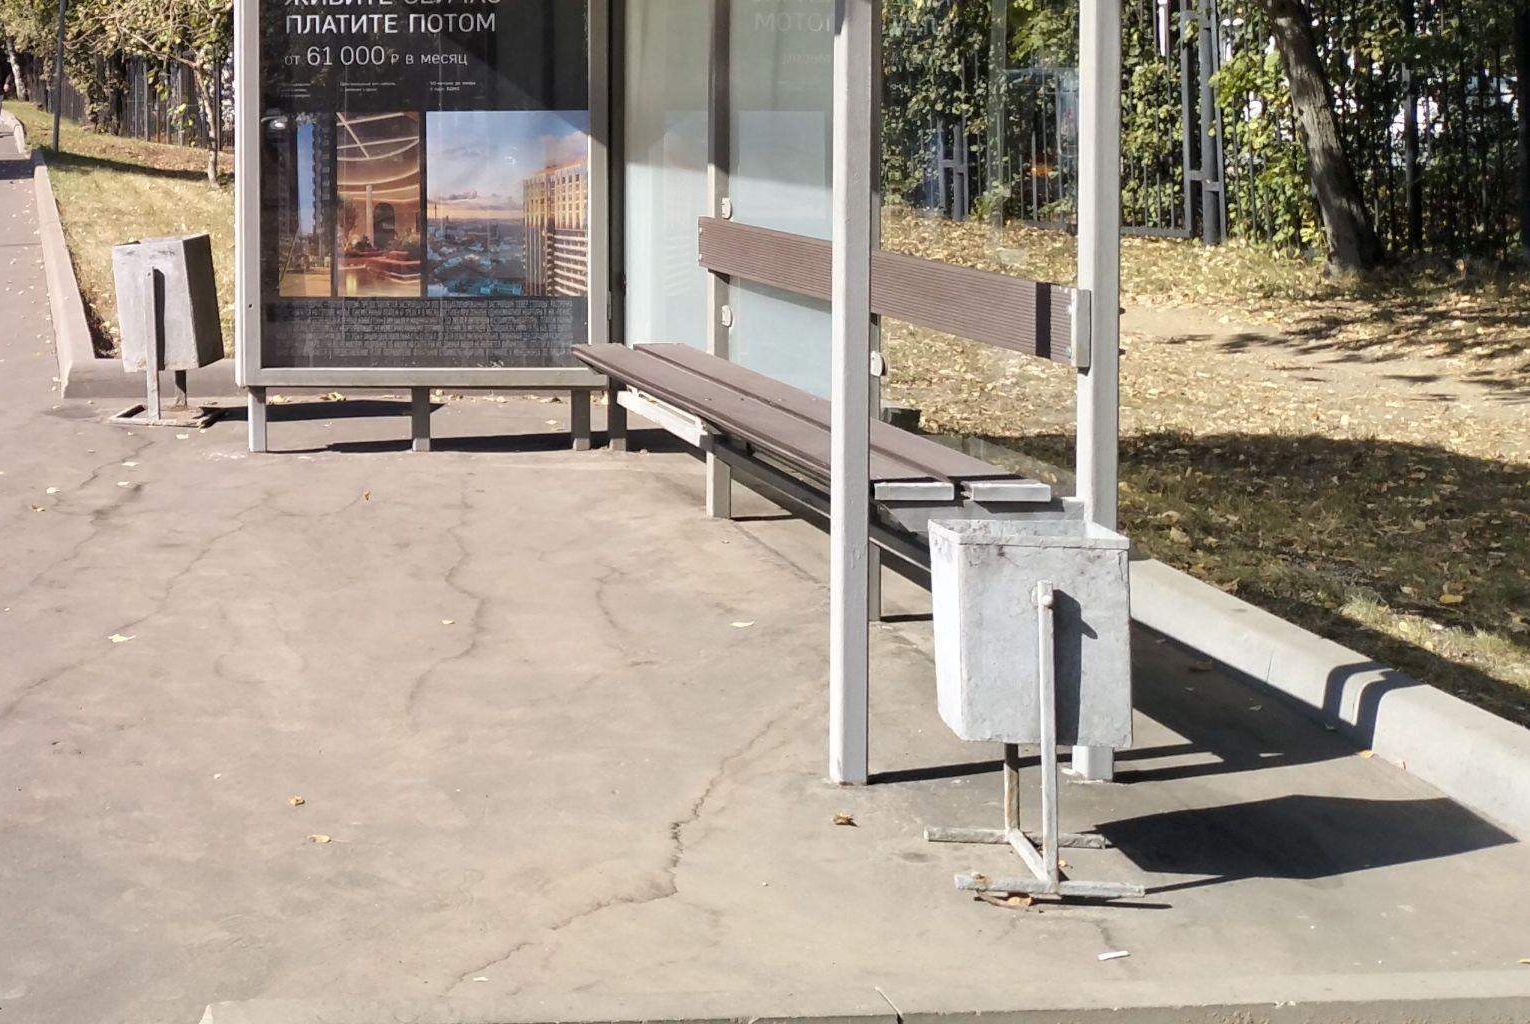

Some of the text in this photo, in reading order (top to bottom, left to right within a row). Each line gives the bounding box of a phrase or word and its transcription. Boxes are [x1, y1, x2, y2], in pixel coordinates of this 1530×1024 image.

[285, 12, 497, 35] ПЛАТИТЕ ПОТОМ
[306, 46, 333, 66] 61
[340, 45, 385, 66] 000
[420, 53, 468, 66] месяц
